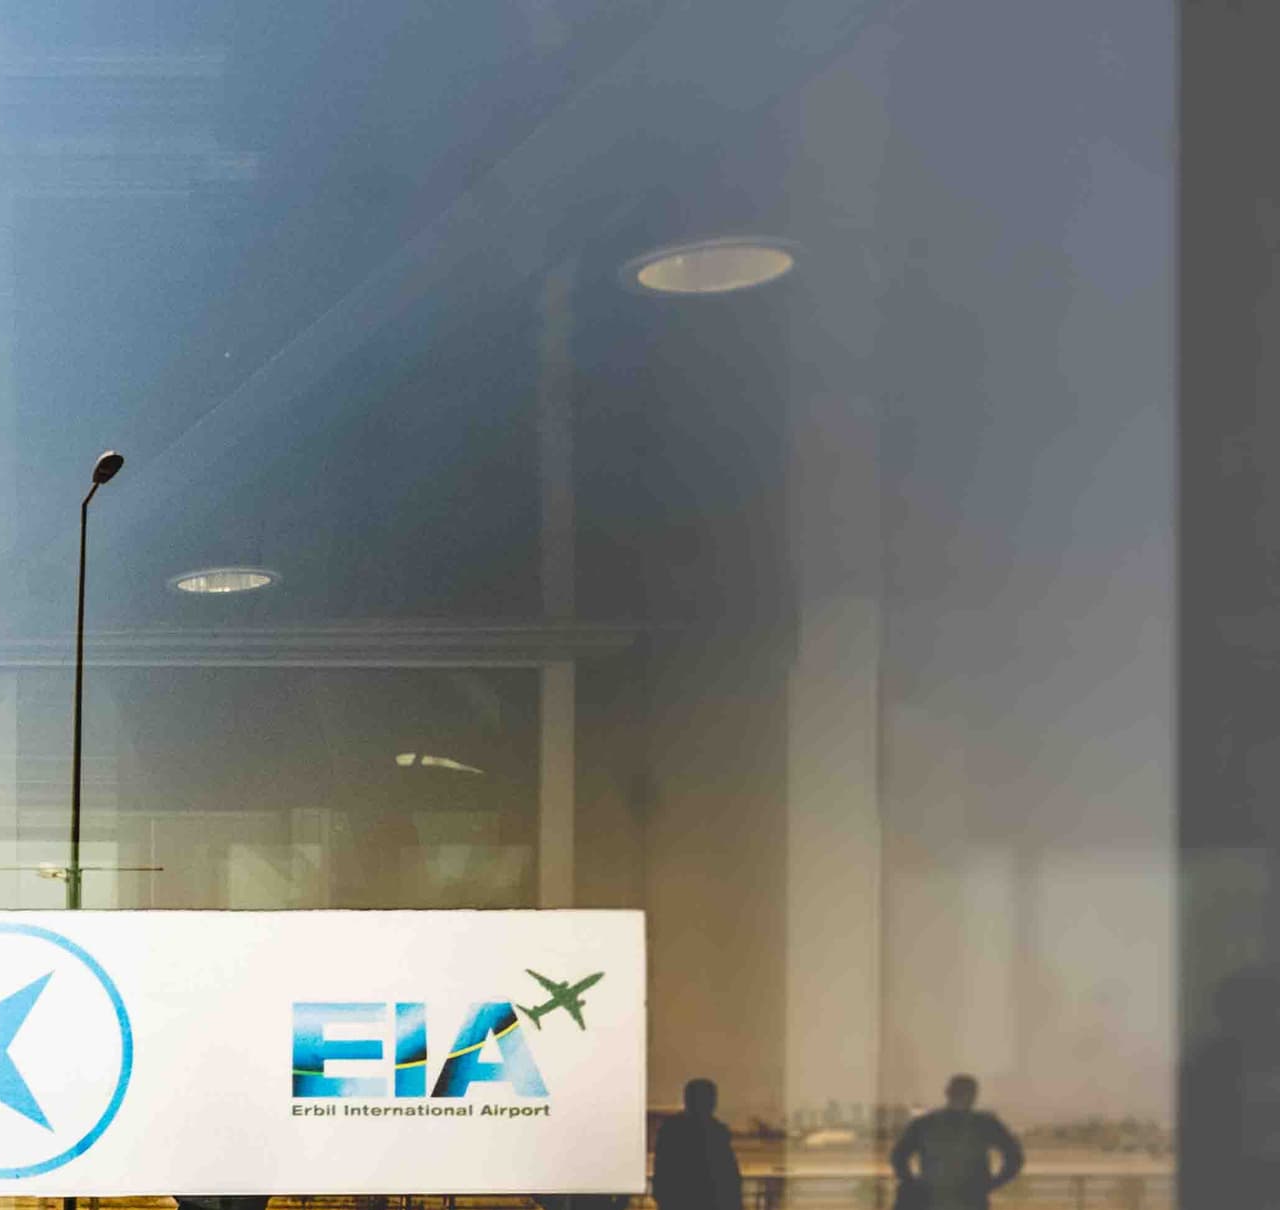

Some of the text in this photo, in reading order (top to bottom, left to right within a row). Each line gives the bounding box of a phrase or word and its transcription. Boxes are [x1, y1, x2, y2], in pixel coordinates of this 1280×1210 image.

[292, 1002, 549, 1098] EIA
[292, 1104, 550, 1119] Erbil International Airport
